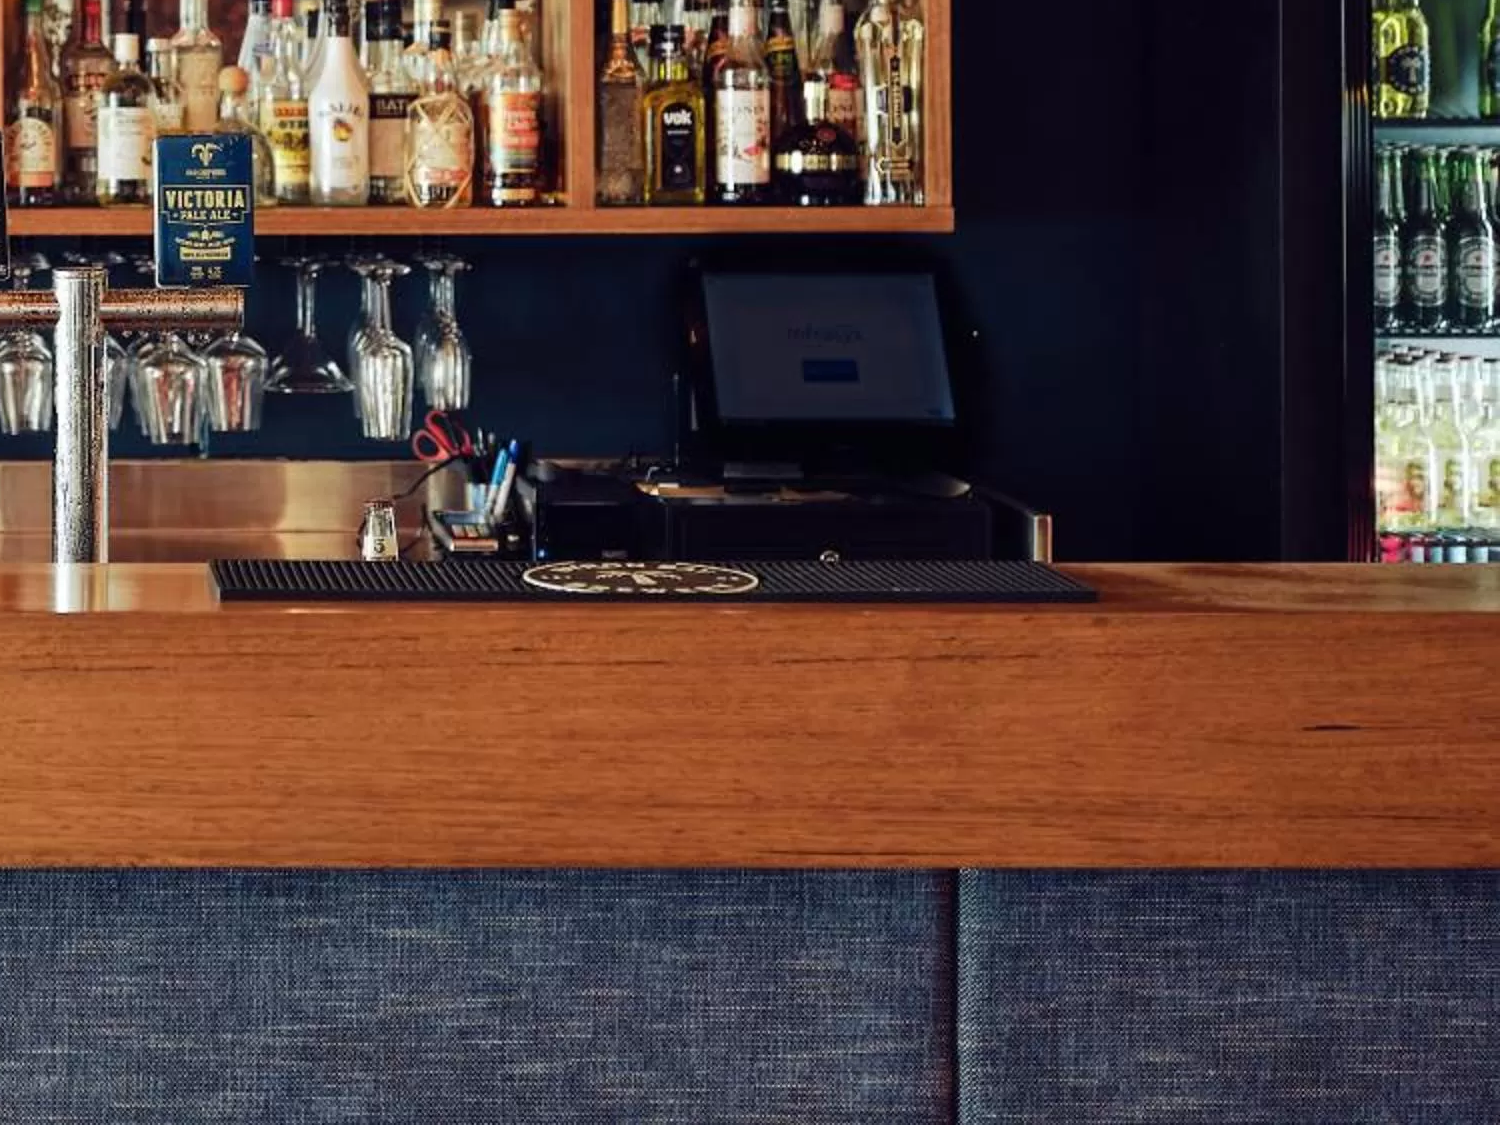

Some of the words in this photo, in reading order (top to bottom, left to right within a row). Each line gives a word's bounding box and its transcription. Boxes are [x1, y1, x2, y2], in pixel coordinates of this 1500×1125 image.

[165, 190, 245, 210] VICTORIA
[180, 210, 207, 220] PALE
[209, 210, 231, 220] ALE
